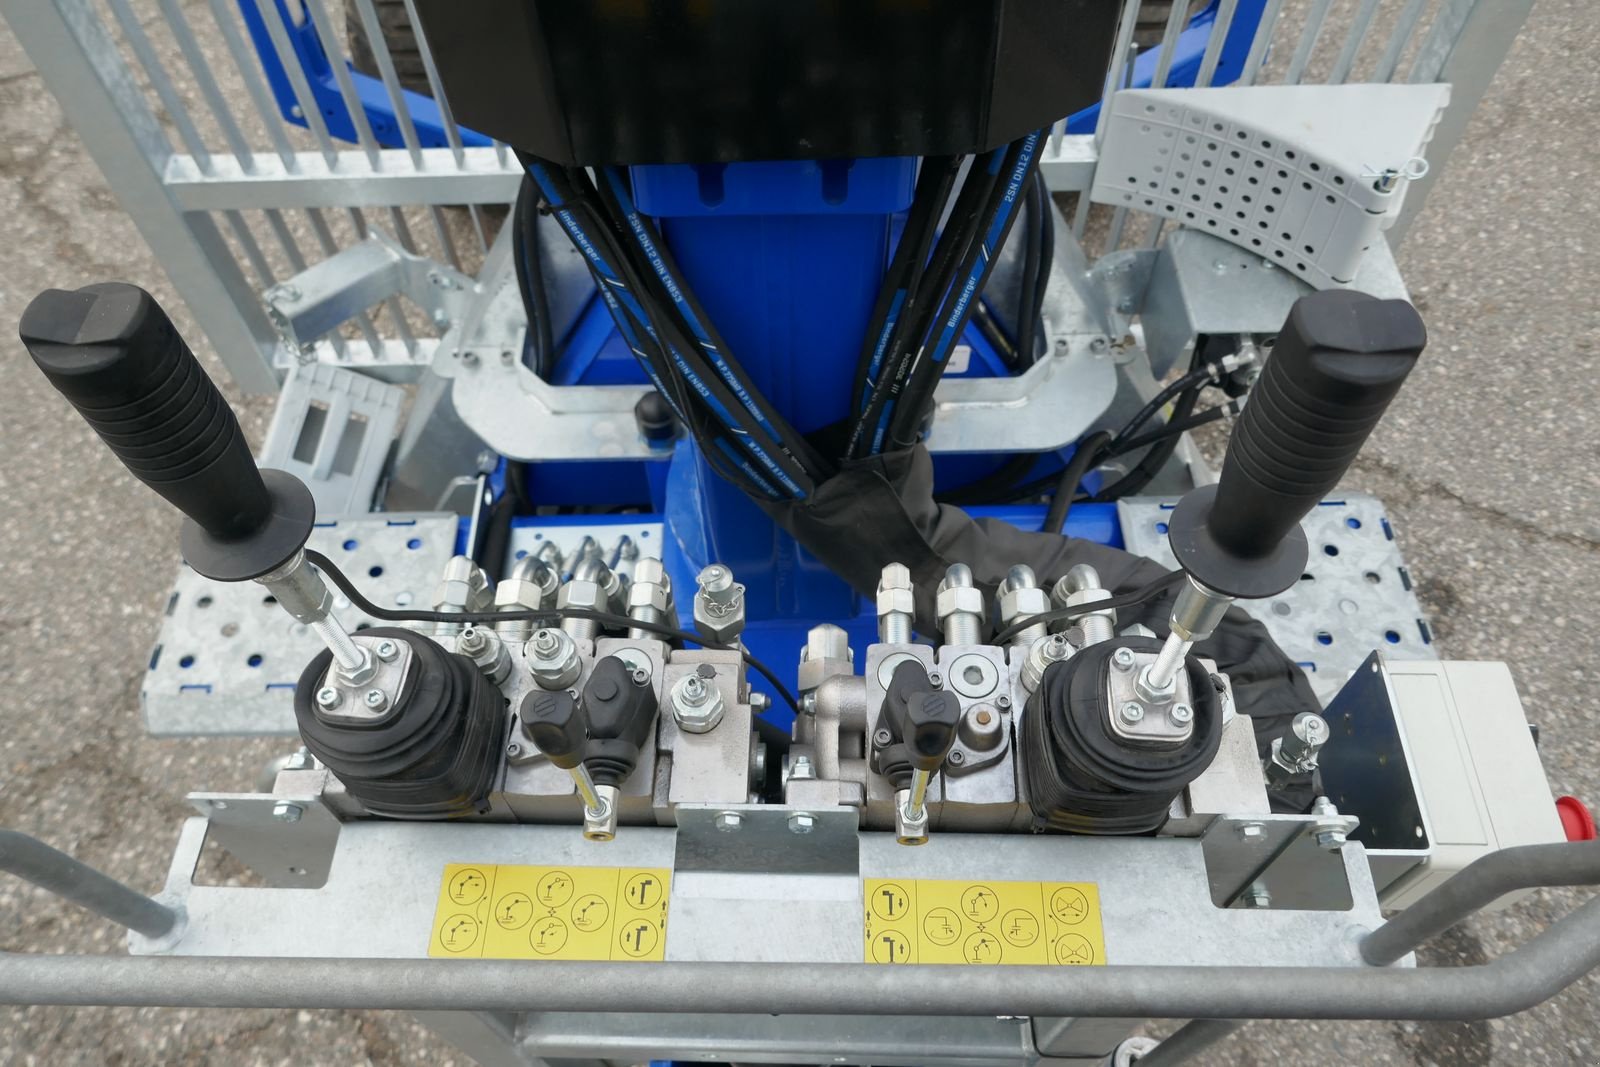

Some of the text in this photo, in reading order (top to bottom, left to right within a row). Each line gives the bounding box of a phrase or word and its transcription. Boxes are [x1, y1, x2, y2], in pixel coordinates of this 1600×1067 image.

[1004, 134, 1037, 202] 2SN DN12 DIN
[628, 212, 683, 303] 2SN DN12 DIN EN853
[947, 276, 976, 328] Binderberger
[676, 361, 710, 397] DIN EN853
